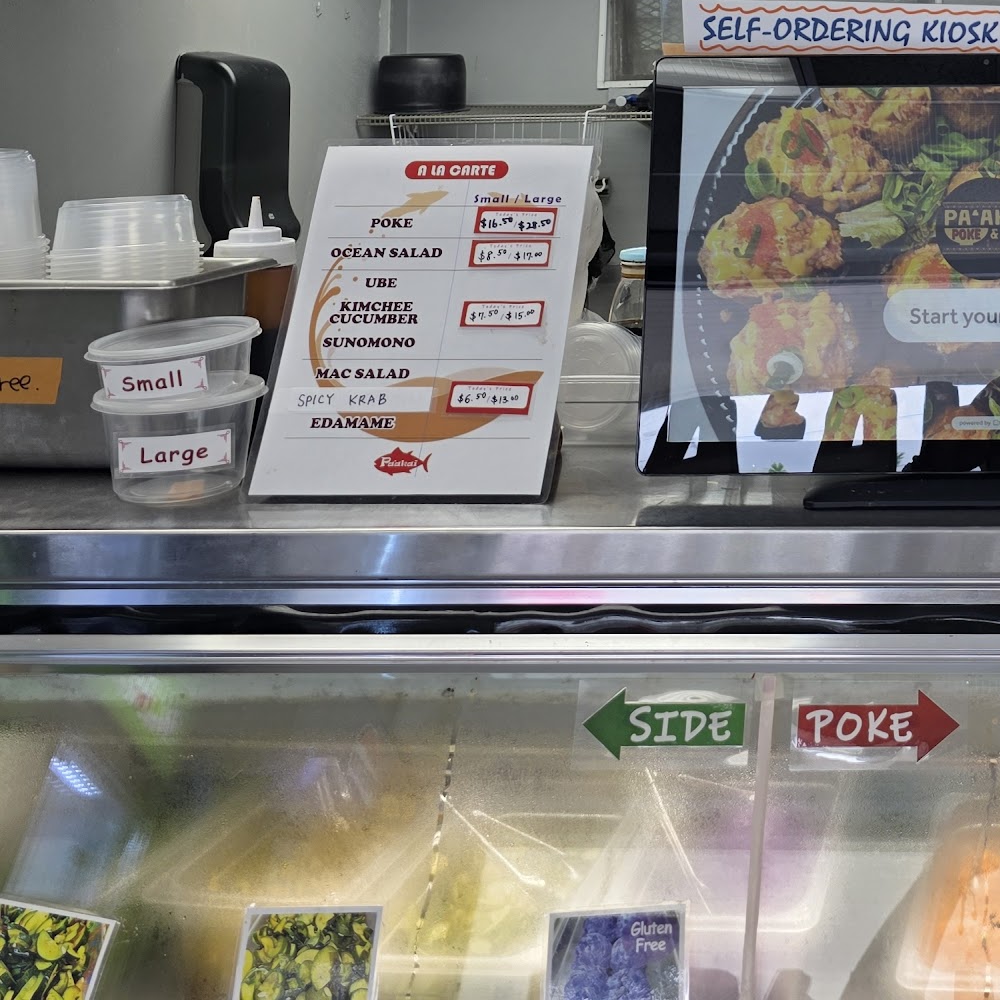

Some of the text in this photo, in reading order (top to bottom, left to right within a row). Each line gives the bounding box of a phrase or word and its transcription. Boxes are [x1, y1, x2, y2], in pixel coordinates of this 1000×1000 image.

[703, 15, 999, 46] SELF-ORDERING KIOSK
[417, 164, 497, 177] A LA CARTE
[474, 194, 562, 204] Small Large
[371, 218, 413, 229] POKE
[951, 228, 982, 241] POKE
[990, 228, 999, 240] &
[330, 247, 443, 259] OCEAN SALAD
[365, 277, 397, 289] UBE
[340, 301, 413, 312] KIMCHEE
[329, 313, 418, 324] CUCUMBER
[910, 307, 959, 324] Start
[322, 337, 416, 348] SUNOMONO
[315, 368, 410, 379] MAC SALAD
[122, 369, 183, 393] Small
[297, 393, 388, 407] SPICY KRAB
[310, 417, 396, 429] EDAMAME
[140, 446, 208, 466] Large
[629, 706, 732, 742] SIDE
[806, 707, 913, 743] POKE
[630, 921, 673, 937] Gluten
[635, 938, 667, 953] Free
